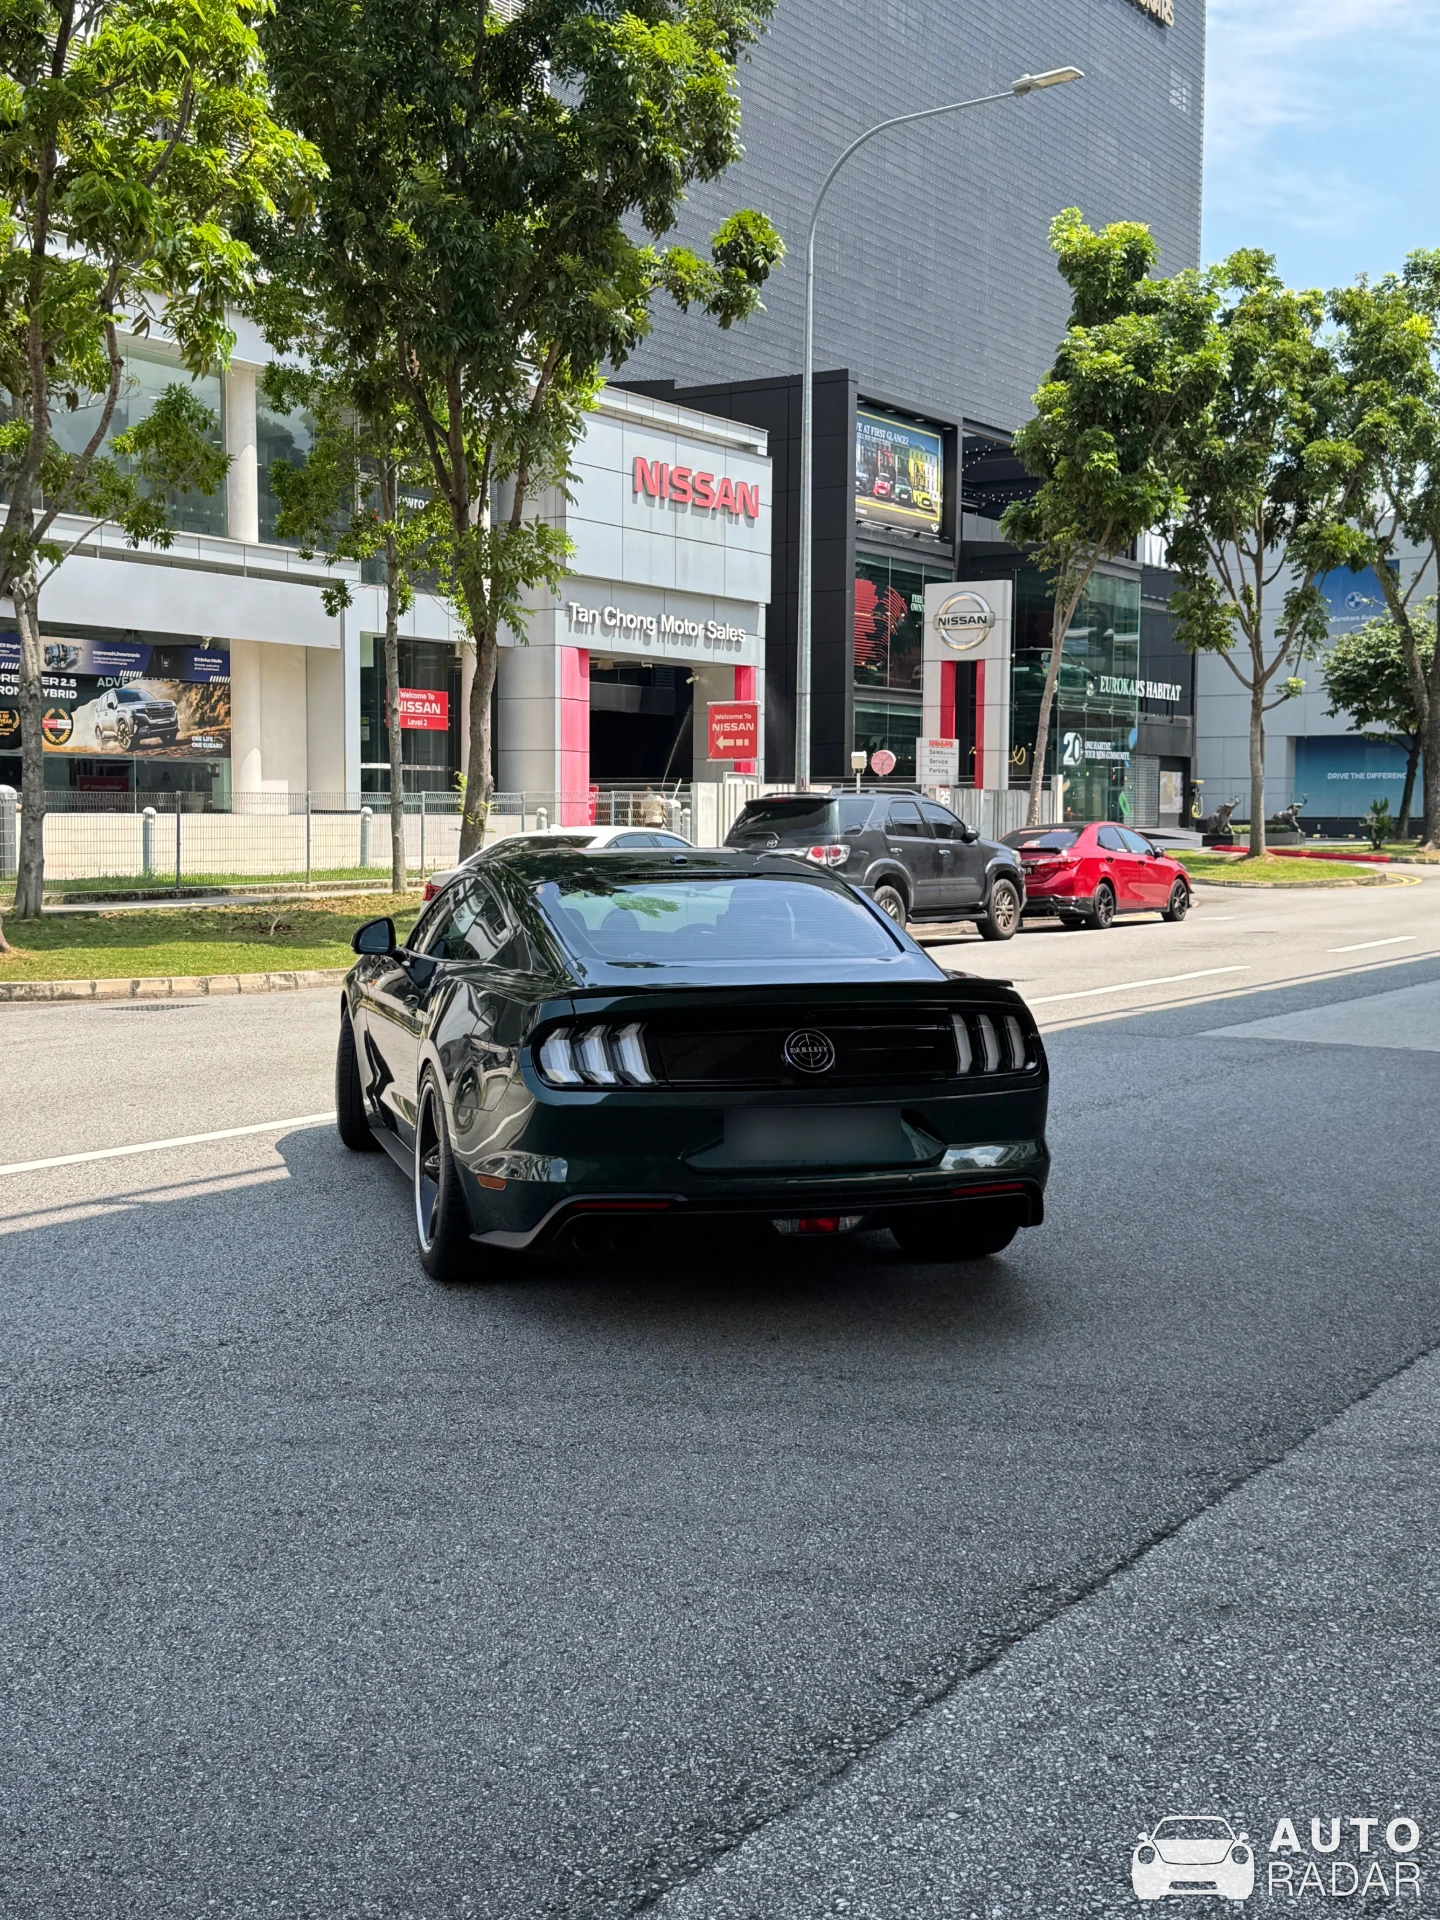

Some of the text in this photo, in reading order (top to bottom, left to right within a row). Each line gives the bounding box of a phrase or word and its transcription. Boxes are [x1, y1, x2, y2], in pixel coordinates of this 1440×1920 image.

[871, 426, 887, 439] FIRST
[633, 456, 759, 518] NISSAN
[568, 602, 746, 642] Tan Chong Motor Sales
[938, 615, 987, 626] NISSAN
[60, 678, 77, 687] 2.5
[42, 688, 78, 699] YBRID
[1100, 676, 1182, 701] EUROKARS HABITAT
[400, 691, 427, 700] Welcome
[407, 718, 422, 726] Level
[712, 722, 754, 731] NISSAN
[928, 740, 953, 748] NISSAN
[1063, 732, 1083, 766] 20
[929, 767, 949, 775] Parking
[1327, 772, 1407, 780] DRIVE THE DIFFERENC
[940, 790, 950, 805] 25
